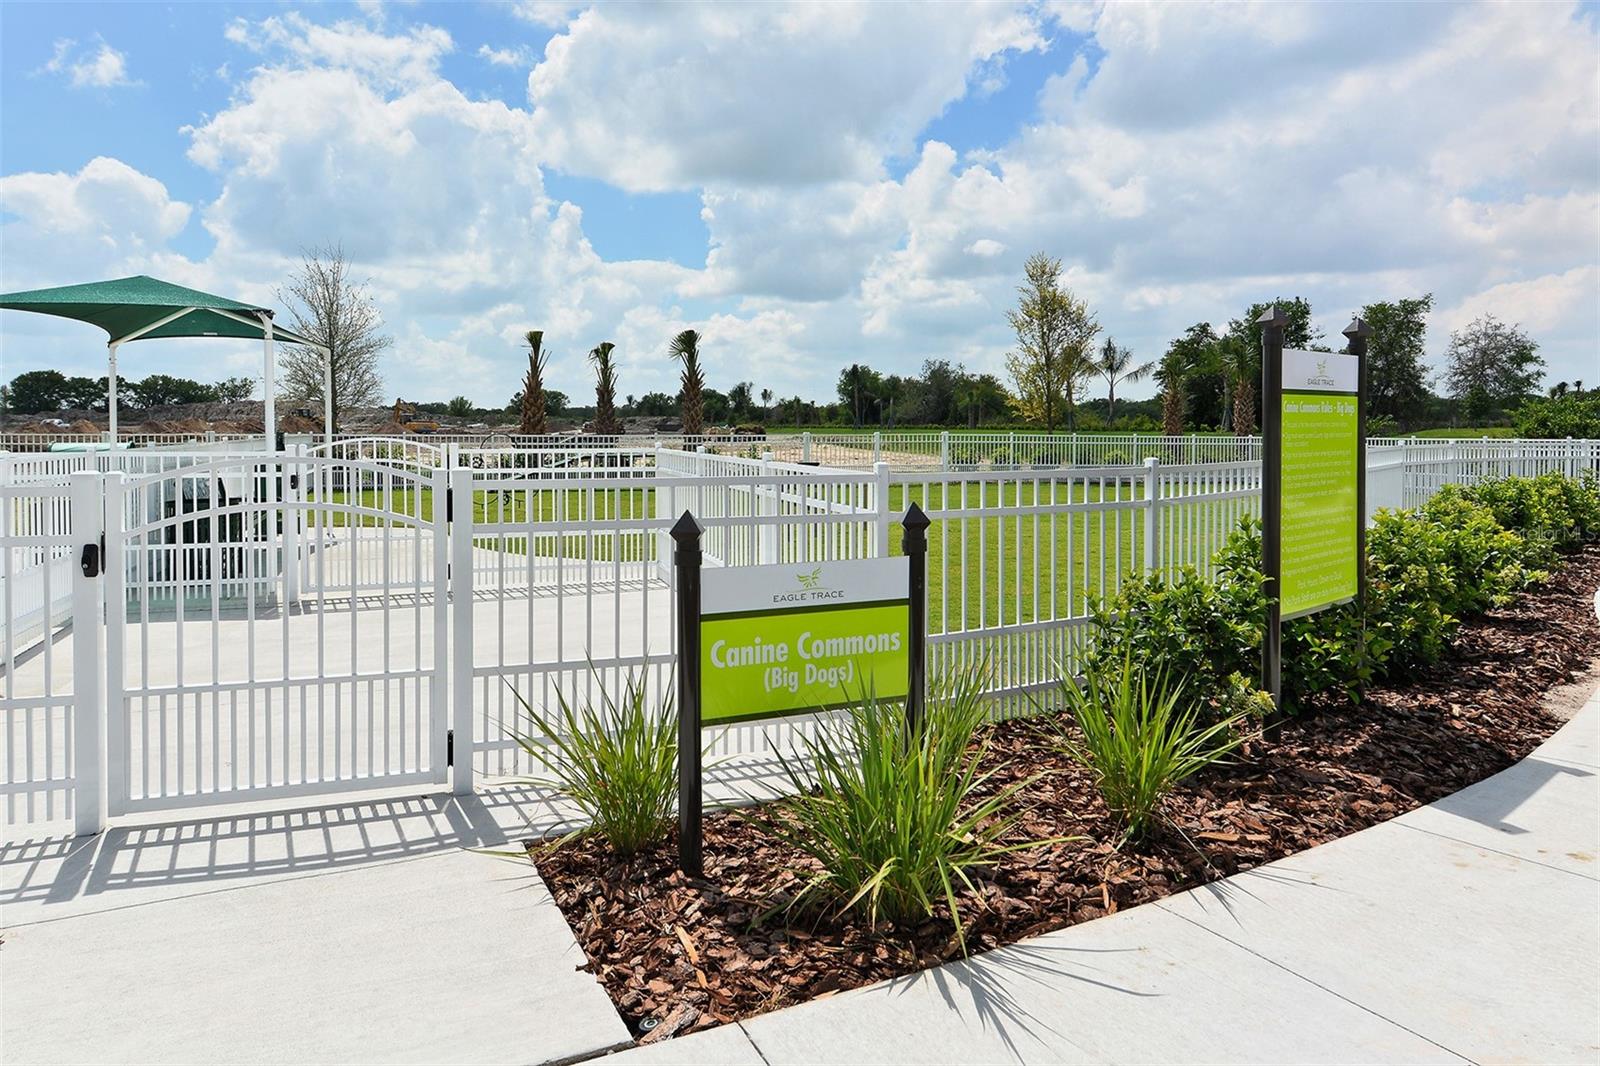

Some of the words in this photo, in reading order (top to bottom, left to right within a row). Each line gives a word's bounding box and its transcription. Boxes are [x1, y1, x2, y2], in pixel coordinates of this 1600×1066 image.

[1307, 378, 1321, 386] EAGLE
[1283, 400, 1298, 413] Canine
[1299, 401, 1320, 414] Commons
[1321, 401, 1333, 414] Rules
[1345, 402, 1355, 416] Dogs
[773, 592, 807, 603] EAGLE
[811, 590, 844, 600] TRACE
[711, 636, 789, 669] Canine
[797, 631, 901, 659] Commons
[764, 667, 799, 693] (Big
[805, 659, 853, 688] Dogs)
